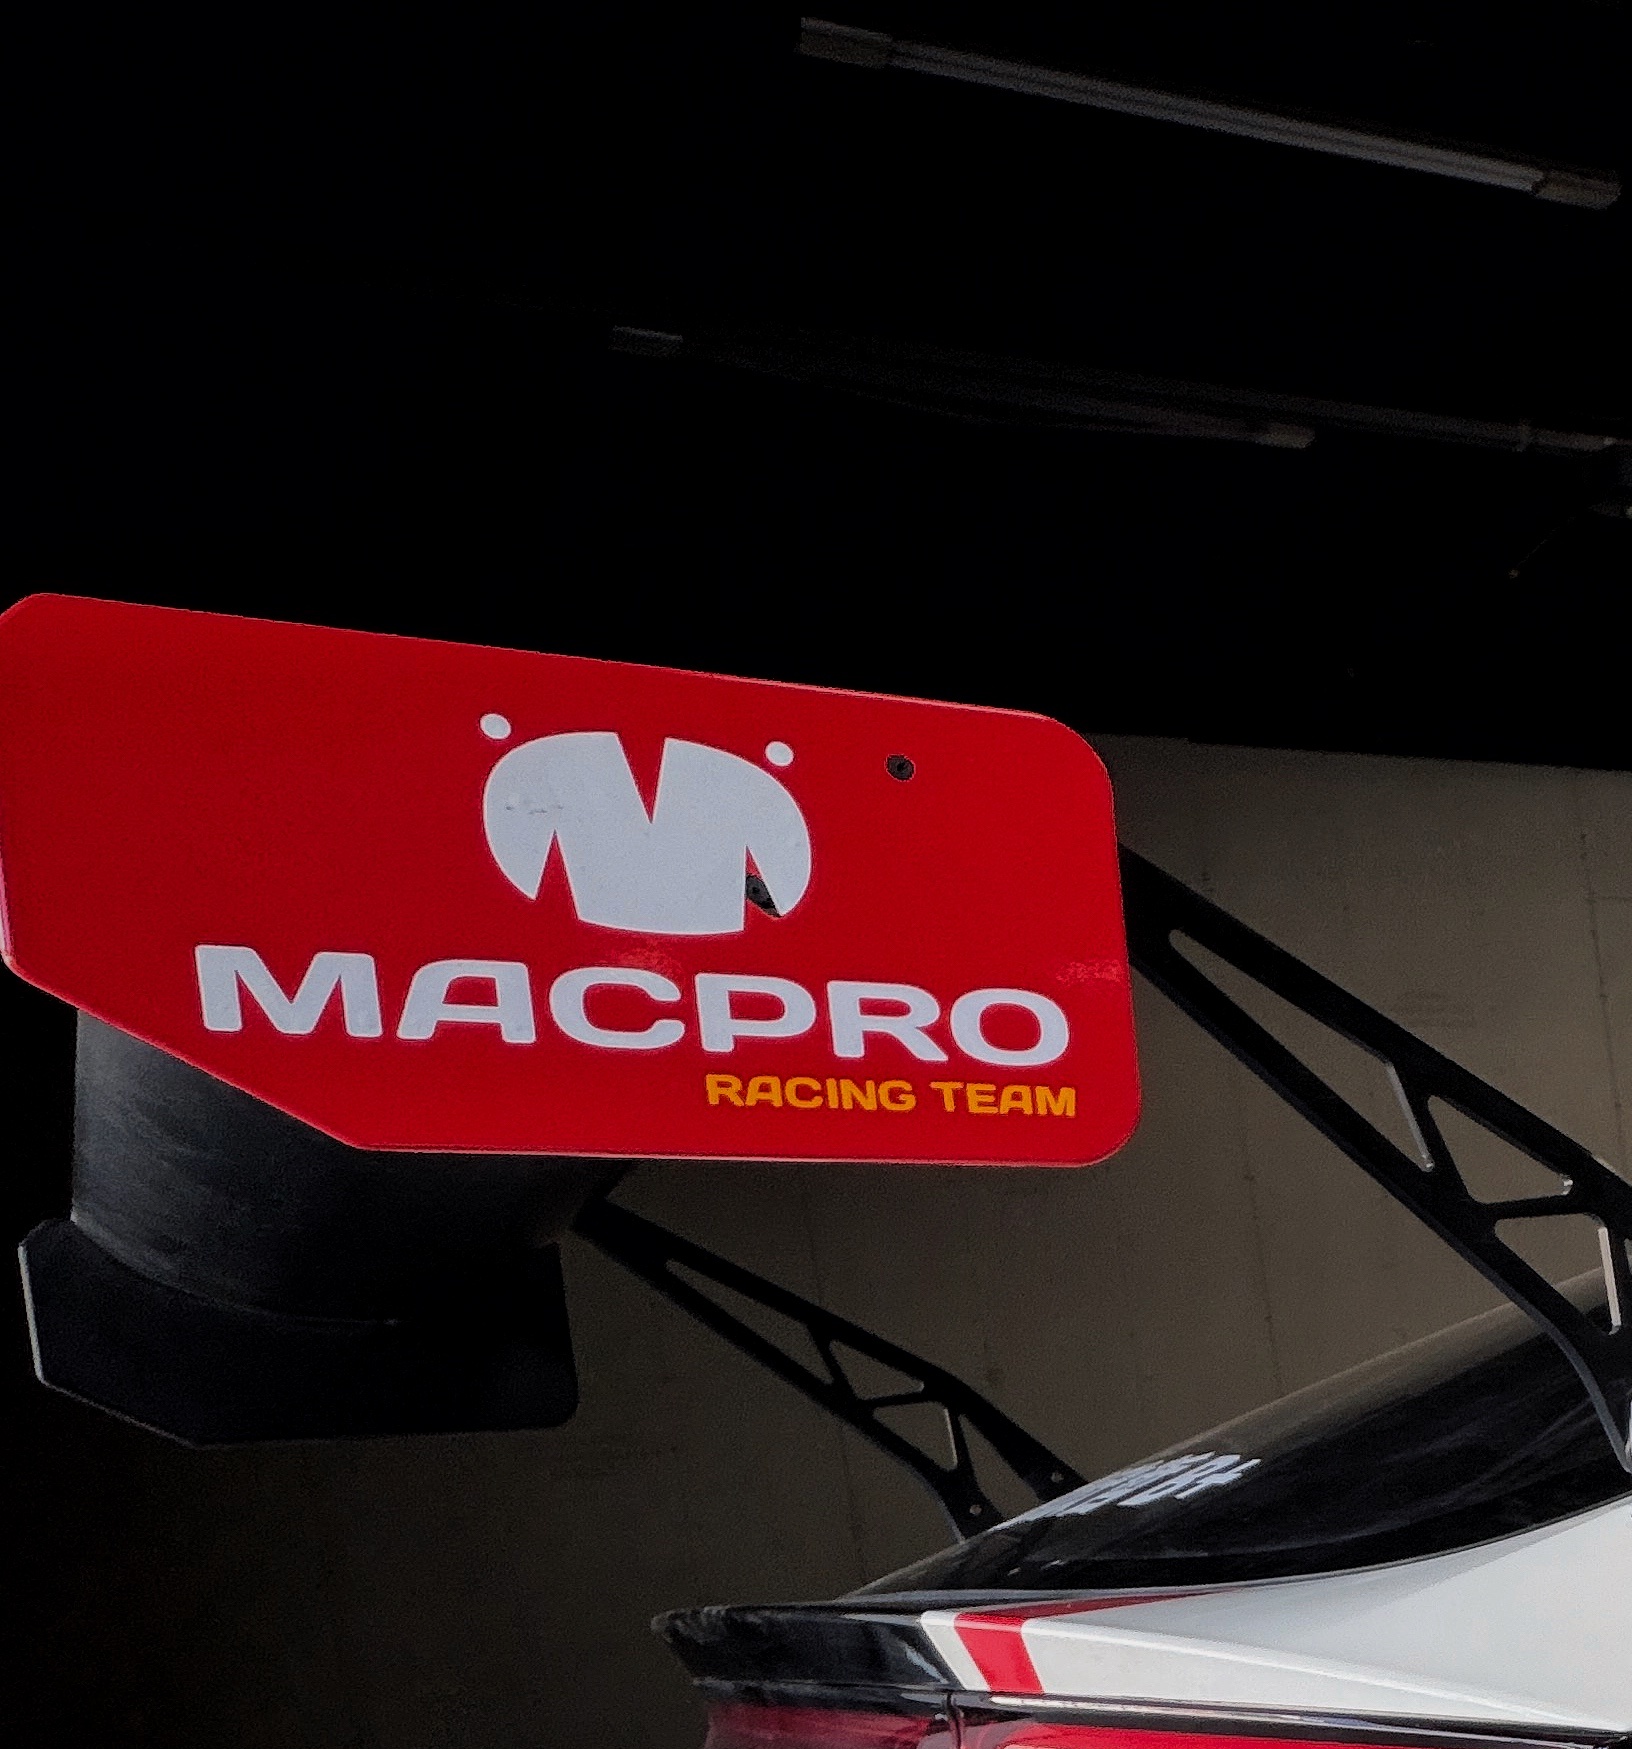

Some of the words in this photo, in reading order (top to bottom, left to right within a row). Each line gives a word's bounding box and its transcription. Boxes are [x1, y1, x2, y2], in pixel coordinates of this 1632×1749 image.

[194, 942, 1071, 1069] MACPRO
[704, 1074, 916, 1113] RACING
[929, 1080, 1077, 1119] TEAM
